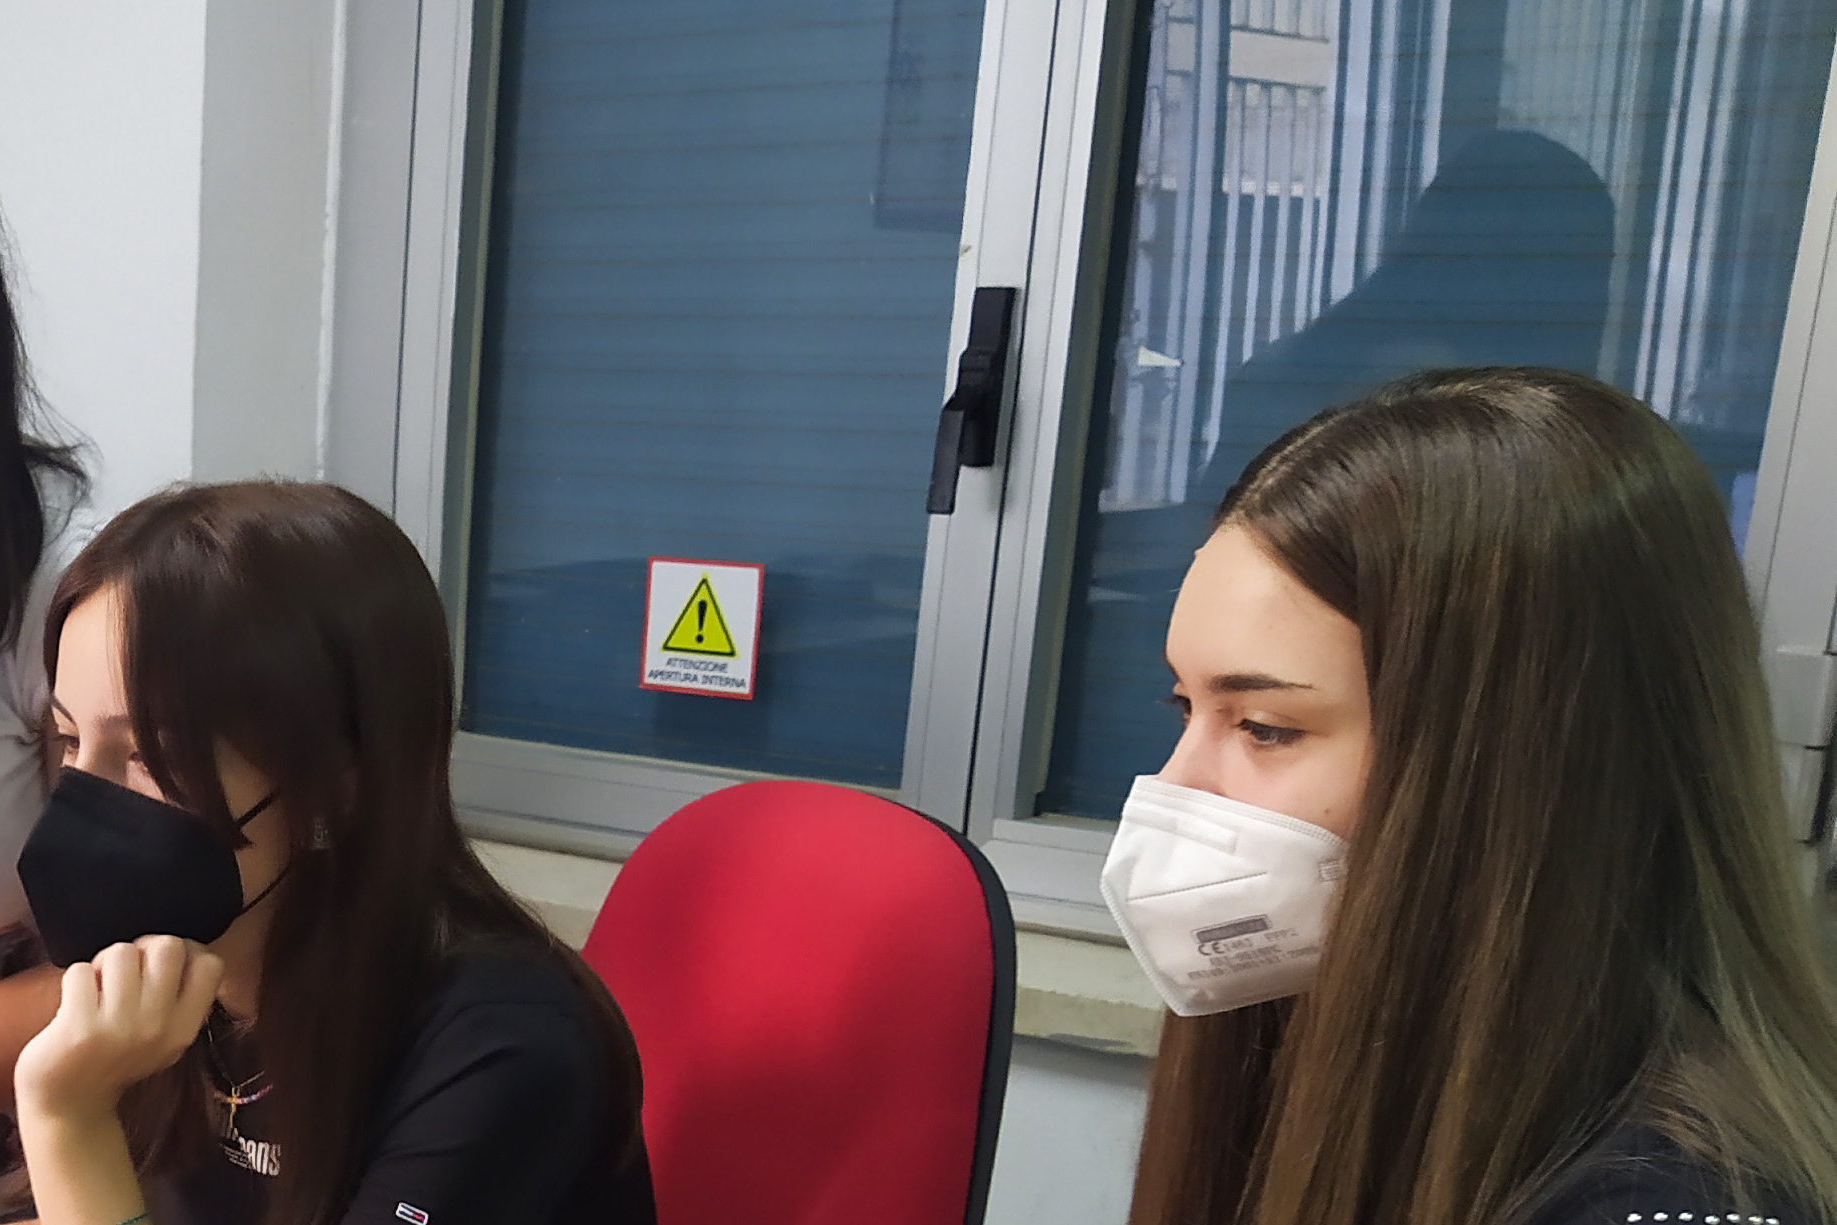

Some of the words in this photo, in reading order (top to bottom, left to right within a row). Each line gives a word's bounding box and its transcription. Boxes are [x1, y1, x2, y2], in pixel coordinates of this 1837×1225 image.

[666, 658, 728, 672] ATTENZIONE
[648, 669, 699, 683] APERTURA
[701, 674, 747, 688] INTERNA
